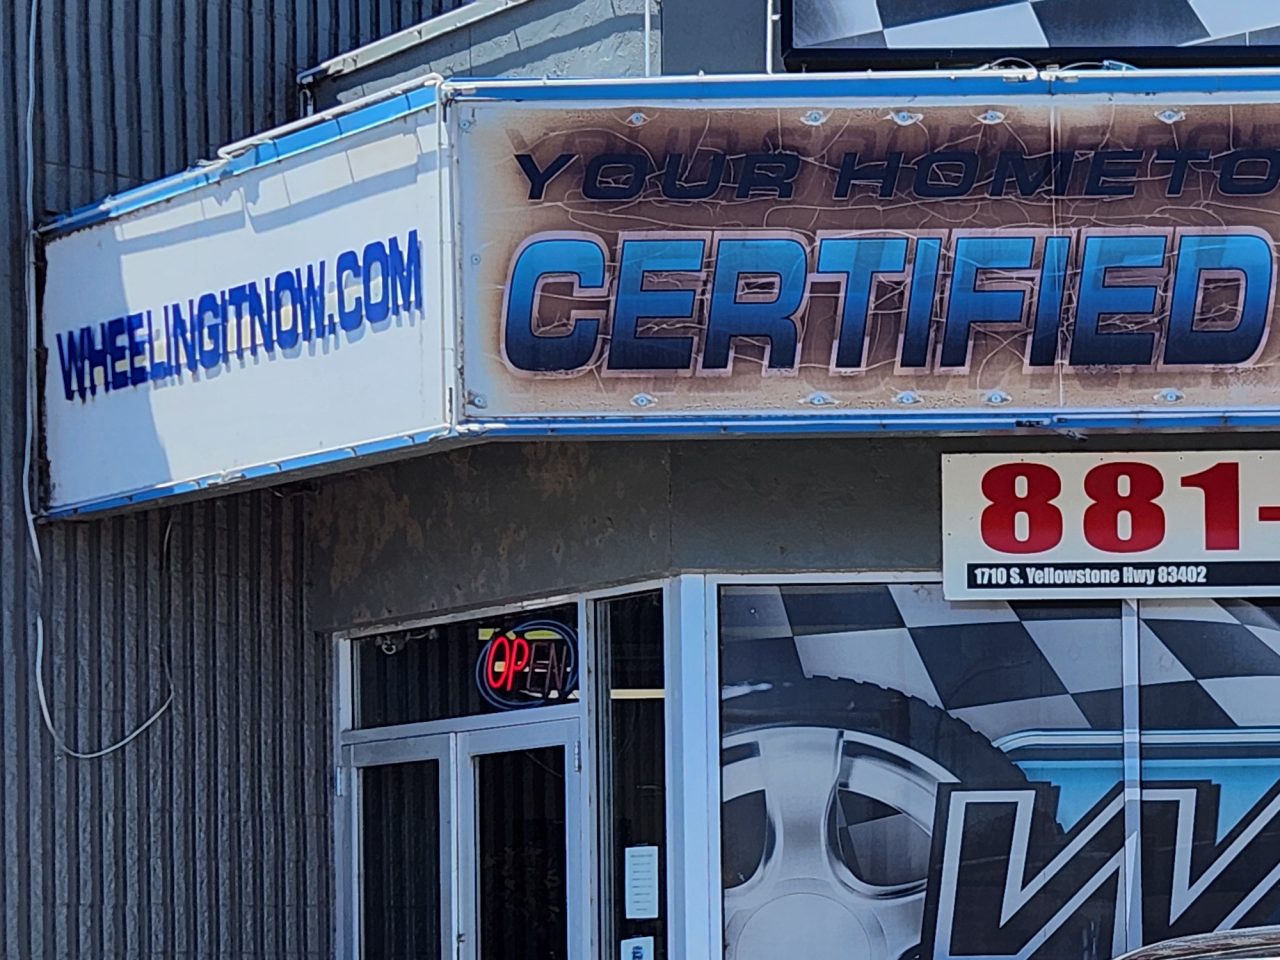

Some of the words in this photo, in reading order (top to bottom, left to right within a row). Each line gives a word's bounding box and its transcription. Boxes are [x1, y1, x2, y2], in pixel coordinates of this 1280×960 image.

[514, 149, 804, 202] YOUR
[56, 229, 424, 404] WHEELINGITNOW.COM
[500, 227, 1276, 377] CERTIFIED
[974, 567, 1007, 585] 1710
[1010, 567, 1024, 584] S.
[1027, 566, 1120, 585] Yellowstone
[1123, 566, 1155, 585] Hwy
[1158, 566, 1207, 583] 83402
[487, 636, 568, 696] OPEN
